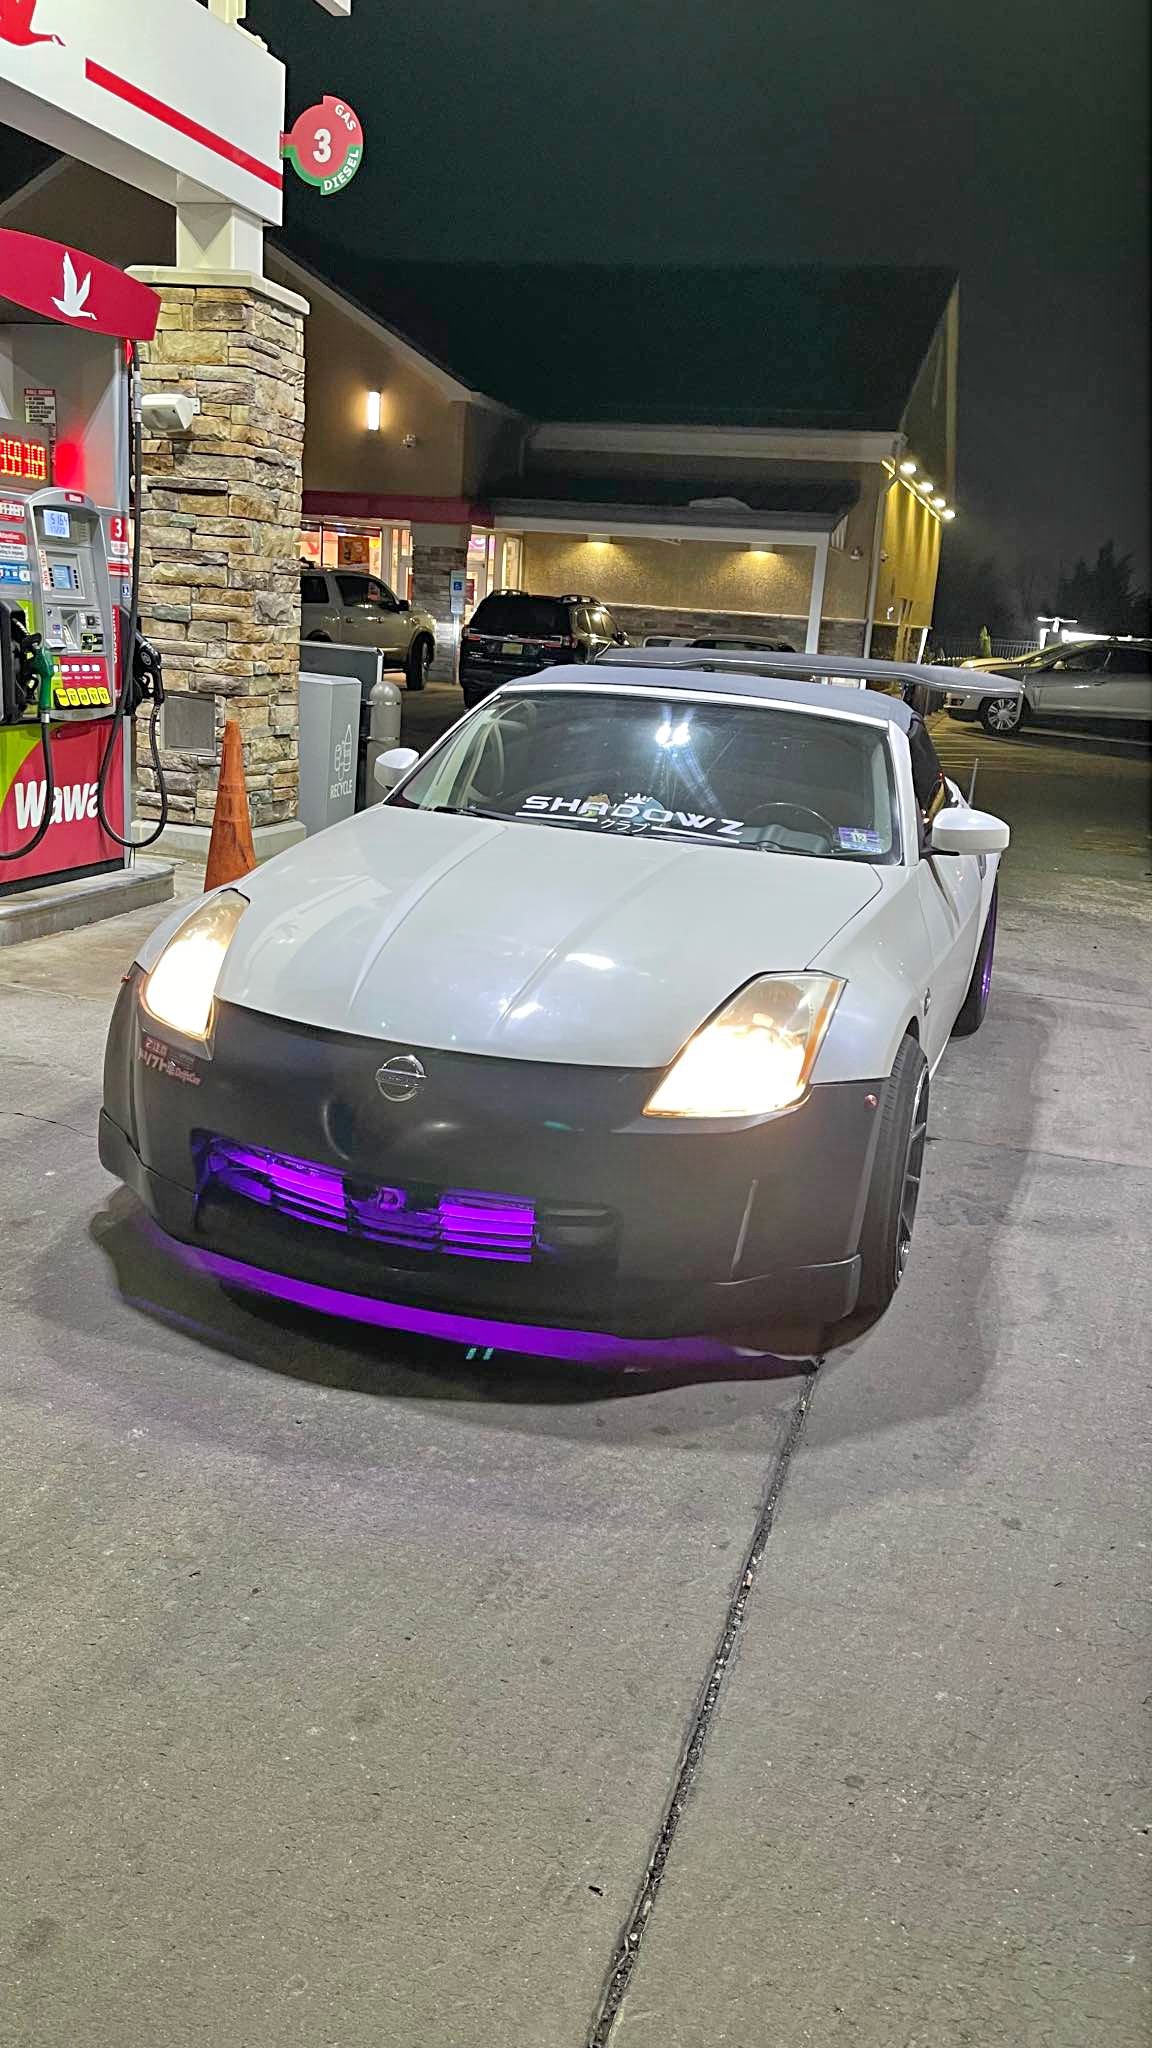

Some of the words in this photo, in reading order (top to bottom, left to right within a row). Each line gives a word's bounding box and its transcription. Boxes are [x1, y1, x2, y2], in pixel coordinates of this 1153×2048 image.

[335, 104, 357, 131] GAS
[312, 128, 332, 163] 3
[323, 149, 359, 191] DIESEL
[114, 518, 122, 538] 3
[329, 779, 353, 799] RECYCLE
[14, 779, 99, 830] Wawa
[600, 818, 652, 834] クラブ
